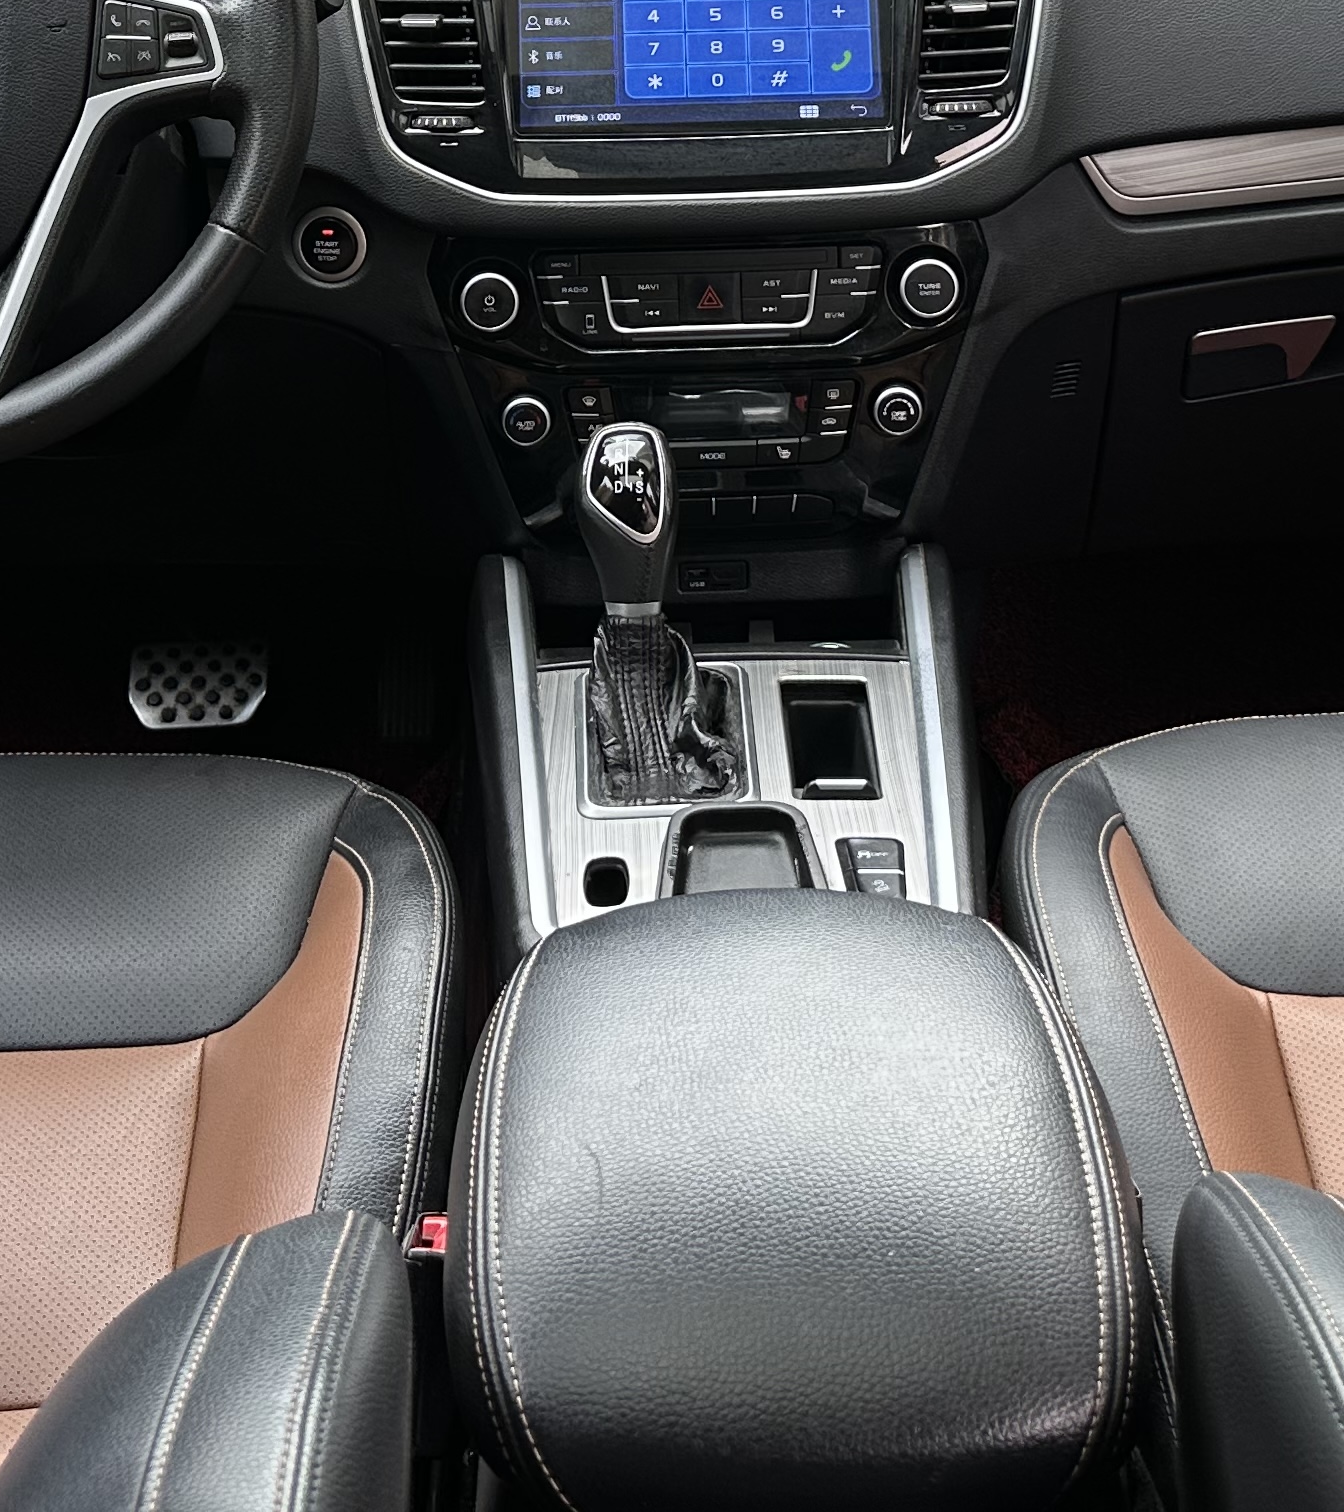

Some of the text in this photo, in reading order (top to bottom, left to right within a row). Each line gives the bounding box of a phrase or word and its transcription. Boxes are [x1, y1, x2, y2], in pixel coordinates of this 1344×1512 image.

[647, 9, 660, 23] 4
[709, 8, 722, 21] 5
[770, 6, 784, 19] 6
[648, 42, 660, 56] 7
[710, 40, 723, 54] 8
[771, 39, 785, 53] 9
[711, 73, 724, 87] 0
[313, 247, 341, 255] ENGINE
[637, 283, 660, 291] NAVI
[516, 419, 535, 427] AUTO
[699, 452, 726, 460] MODE
[614, 463, 624, 476] N
[614, 480, 624, 494] D
[635, 480, 644, 494] S
